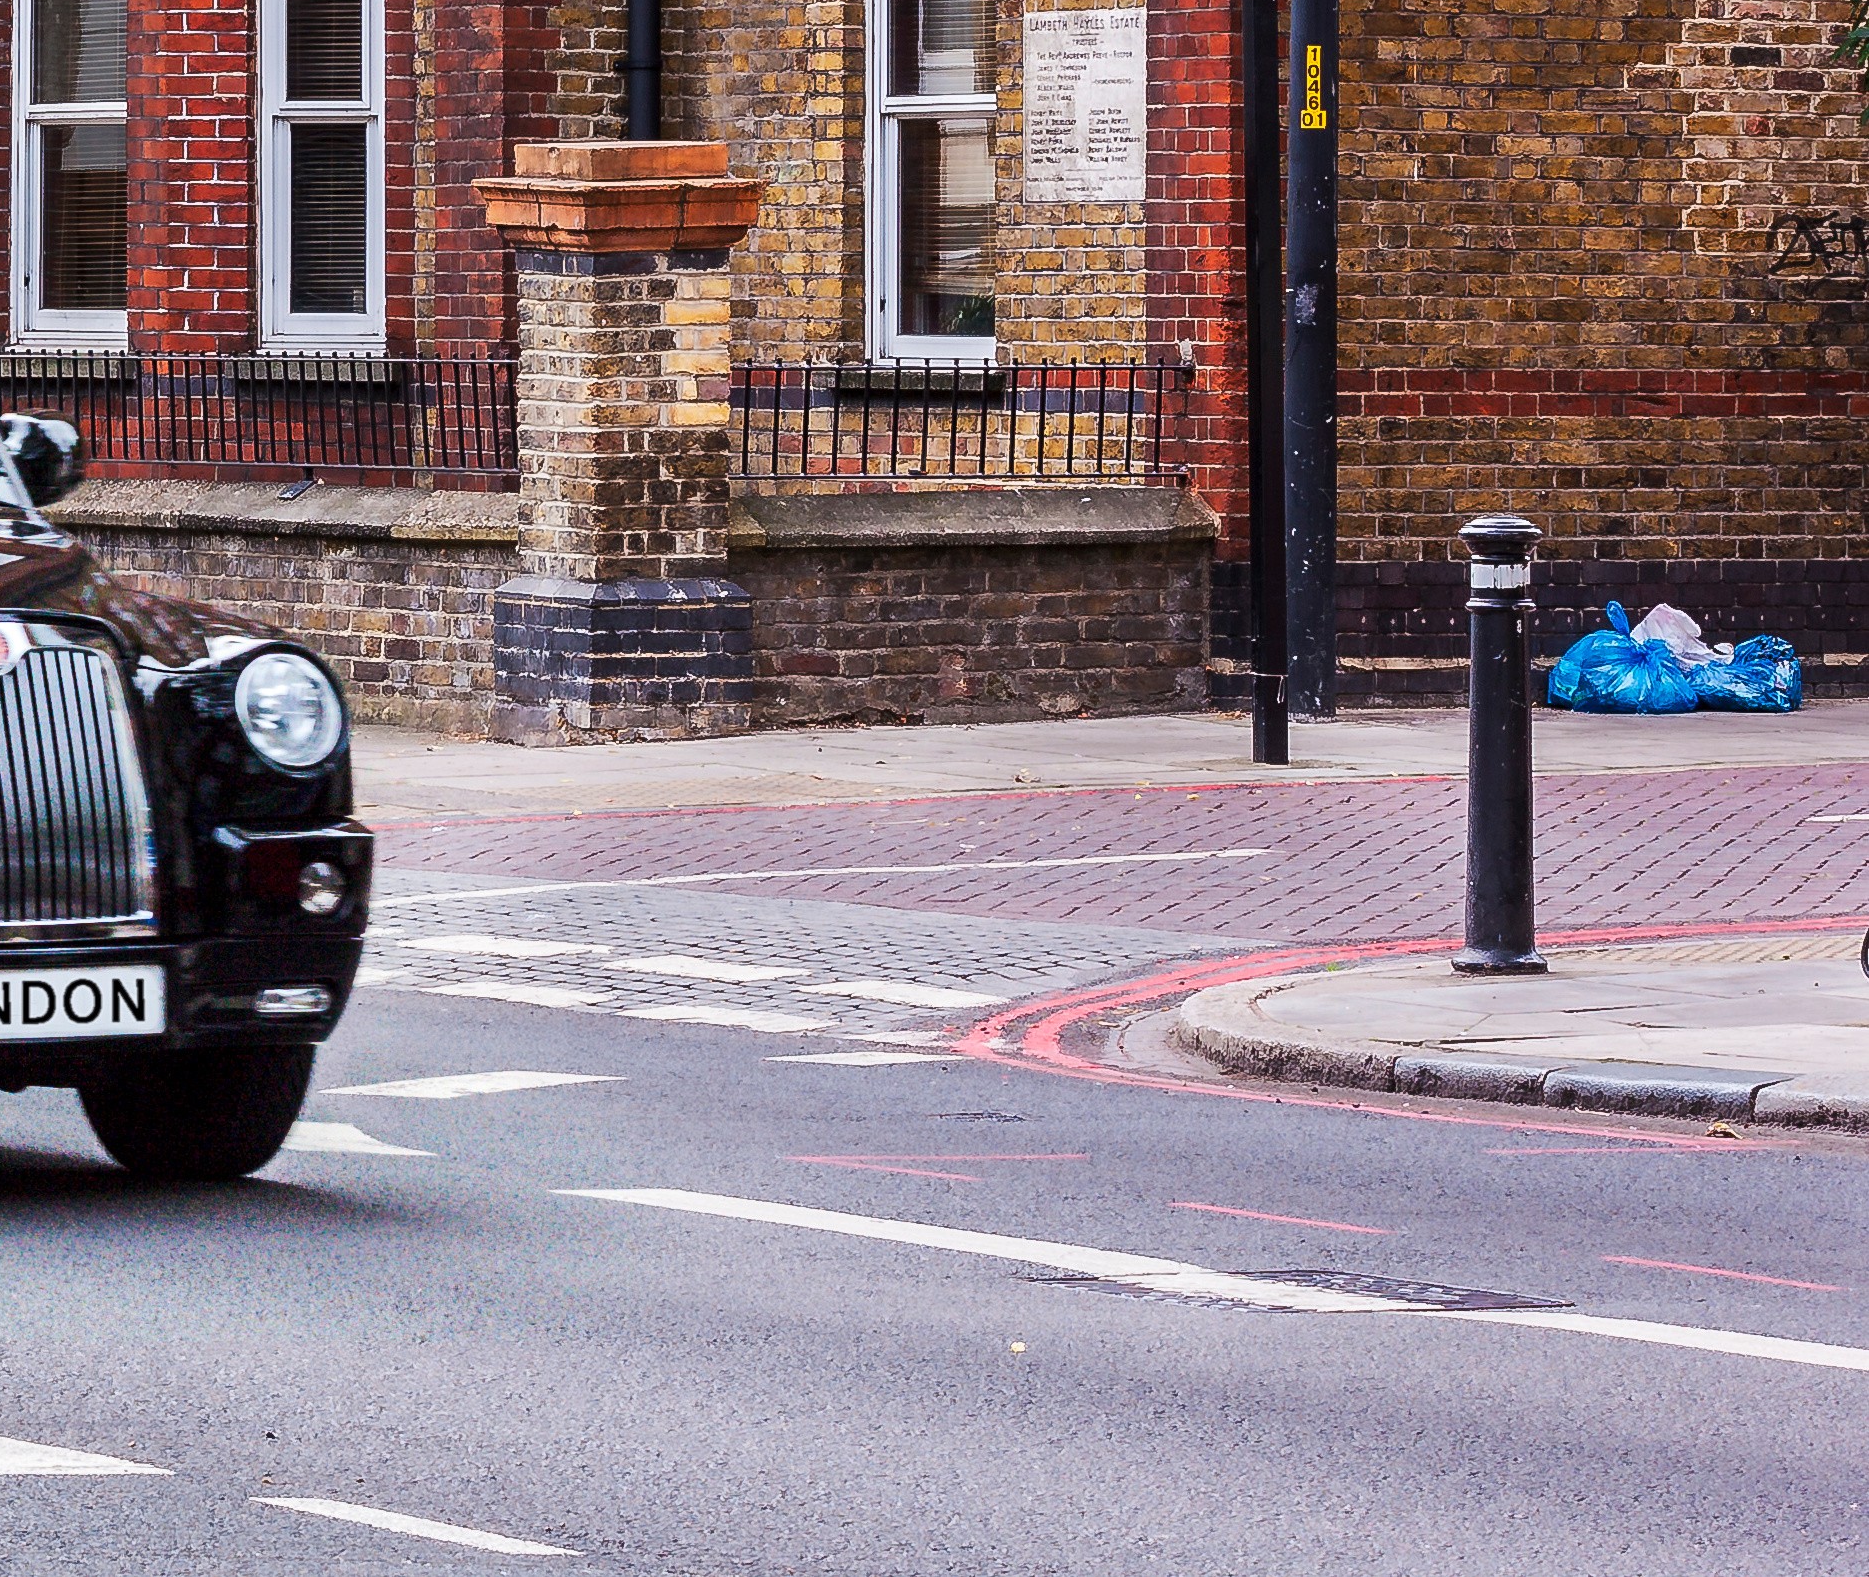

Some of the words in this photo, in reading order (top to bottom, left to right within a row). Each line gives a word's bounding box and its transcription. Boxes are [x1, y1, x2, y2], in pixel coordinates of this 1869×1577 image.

[1029, 18, 1068, 32] LAMBETH
[1073, 15, 1105, 30] HAYLES
[1110, 15, 1140, 30] ESTATE
[1302, 112, 1323, 127] 01
